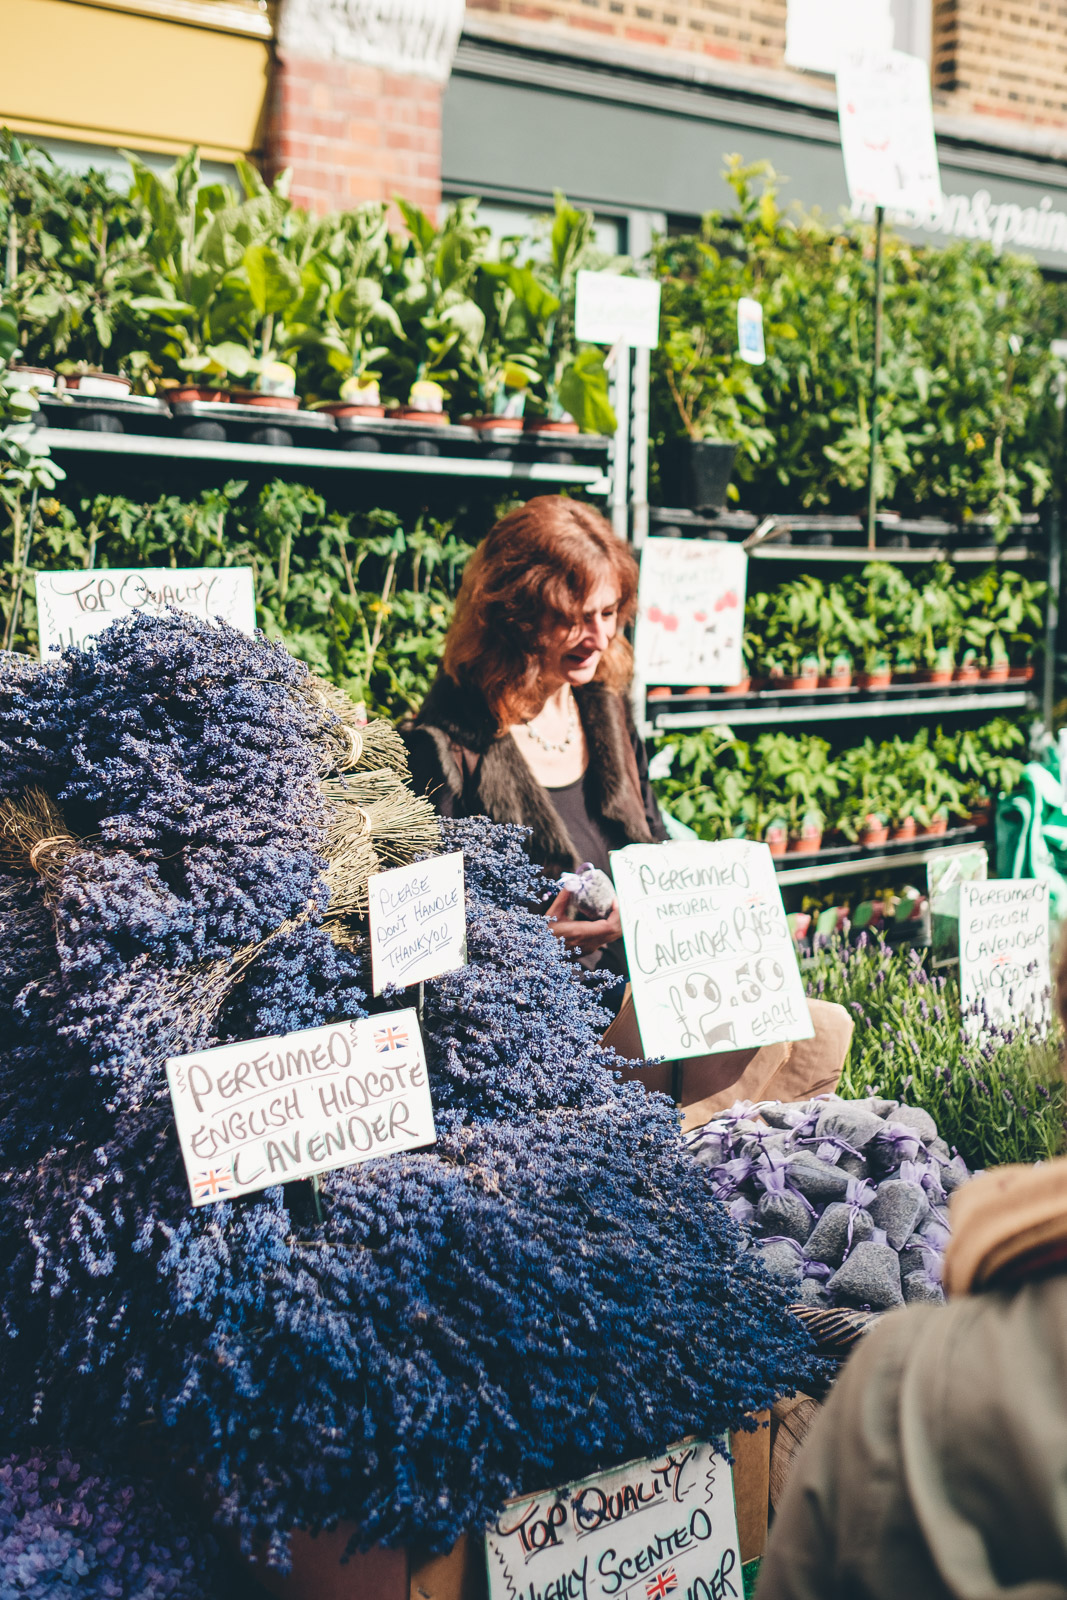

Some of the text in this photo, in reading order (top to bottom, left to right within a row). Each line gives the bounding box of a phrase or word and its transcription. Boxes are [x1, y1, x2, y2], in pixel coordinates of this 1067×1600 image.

[50, 574, 218, 616] TOP QUALITY
[379, 875, 430, 914] PLEASE
[639, 862, 750, 895] PERFUMED
[969, 884, 1046, 908] PERFUMED
[377, 887, 459, 944] DON'T HANDLE
[656, 896, 720, 920] NATURAL
[970, 907, 1030, 934] ENGLISH
[382, 922, 449, 968] THANKYOU
[634, 904, 787, 975] LAVENDER BAGS
[965, 924, 1047, 963] LAVENDER
[752, 997, 798, 1037] EACH
[187, 1031, 351, 1113] PERFUMED
[190, 1088, 304, 1159] ENGLISH
[232, 1101, 419, 1185] LAVENDER
[496, 1446, 698, 1554] TOP QUALITY
[598, 1508, 712, 1593] SCENTED
